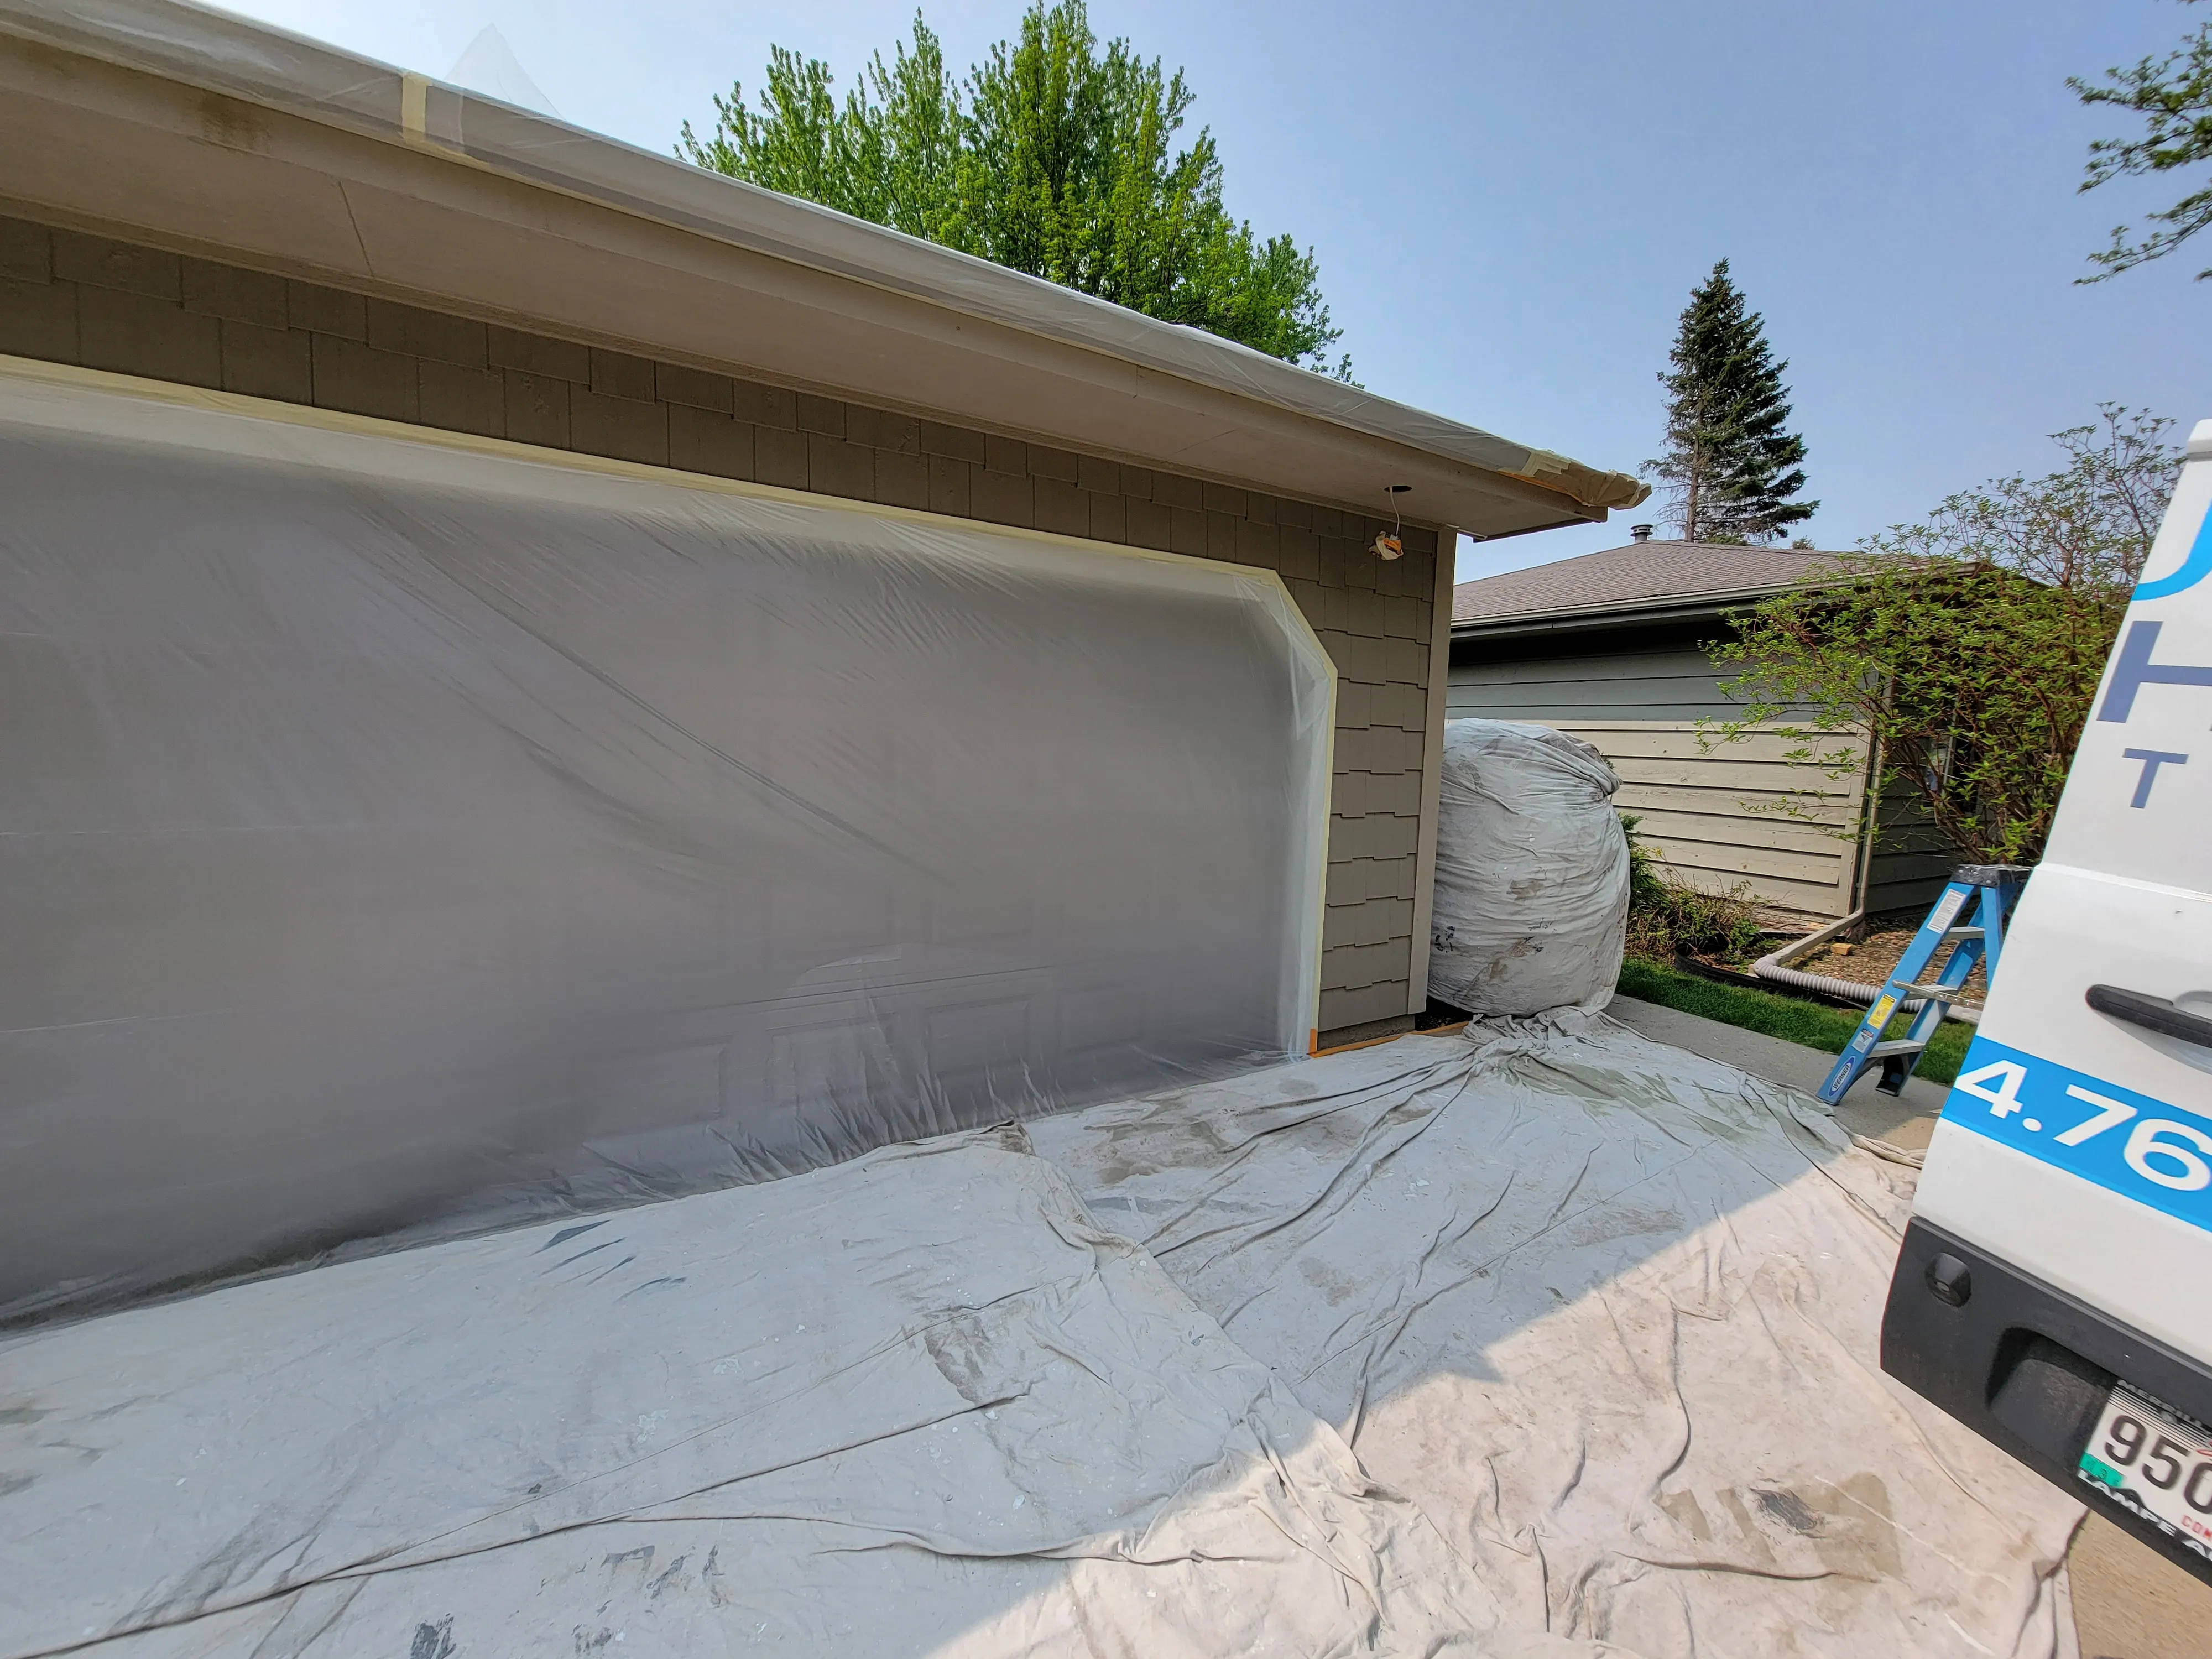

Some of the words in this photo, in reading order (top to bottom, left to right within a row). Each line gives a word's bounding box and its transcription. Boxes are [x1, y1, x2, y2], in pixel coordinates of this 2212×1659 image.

[2122, 748, 2189, 809] T
[1833, 1065, 1850, 1089] WERNER
[2077, 1469, 2177, 1537] LAMPE
